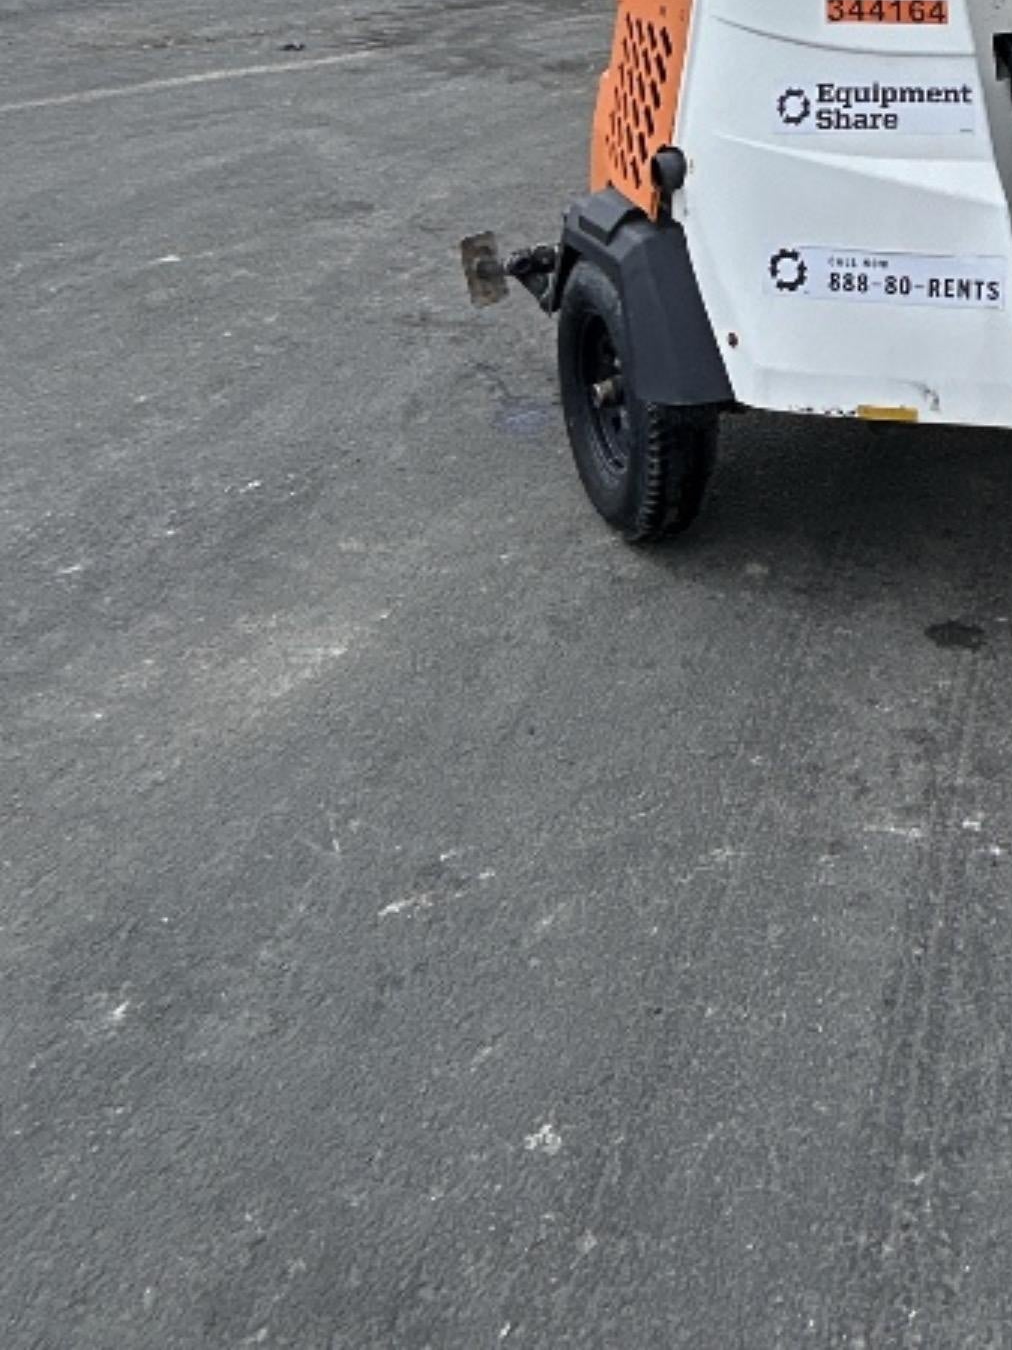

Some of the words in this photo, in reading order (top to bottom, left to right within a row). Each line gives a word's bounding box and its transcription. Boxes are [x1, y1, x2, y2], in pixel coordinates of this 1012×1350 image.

[816, 81, 973, 109] Equipment
[815, 108, 898, 130] Share
[829, 272, 1000, 301] 888-80-RENTS
